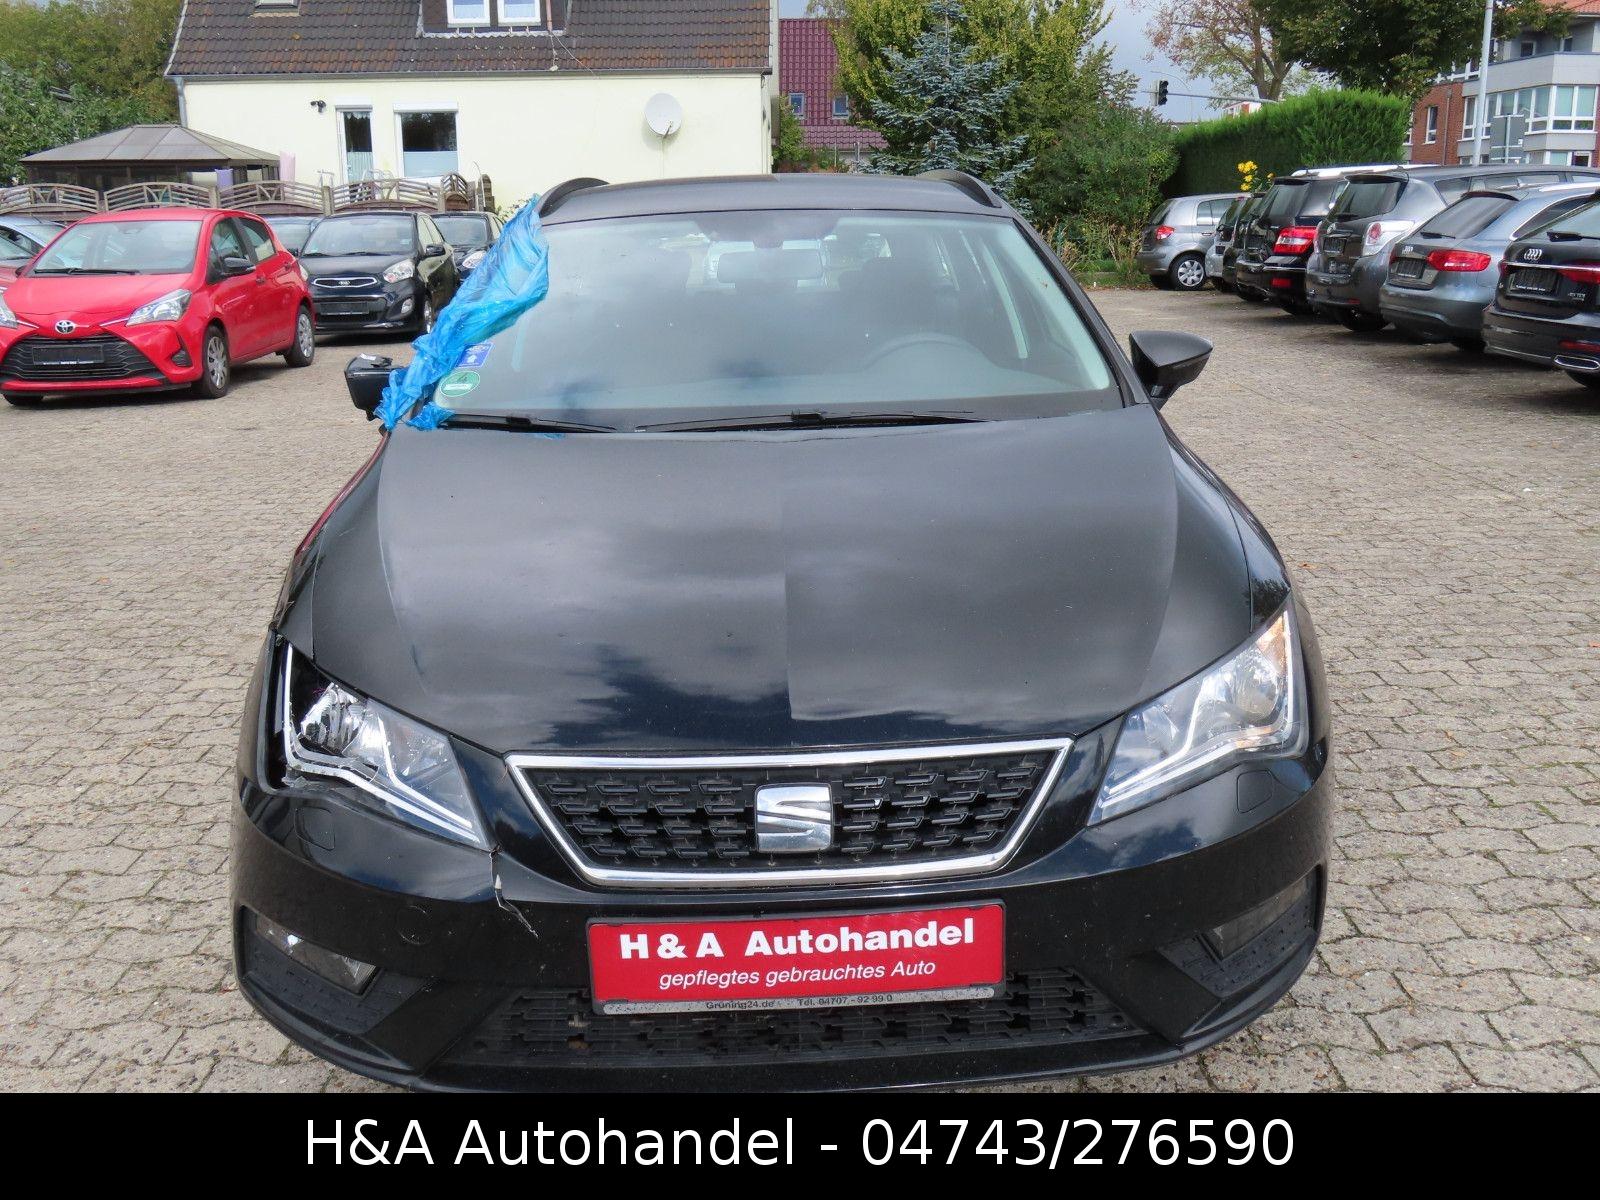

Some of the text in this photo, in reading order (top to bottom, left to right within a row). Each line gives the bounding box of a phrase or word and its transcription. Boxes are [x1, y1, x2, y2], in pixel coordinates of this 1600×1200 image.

[744, 917, 974, 957] Autohandel
[659, 959, 936, 990] gepflegtes gebrauchtes Auto
